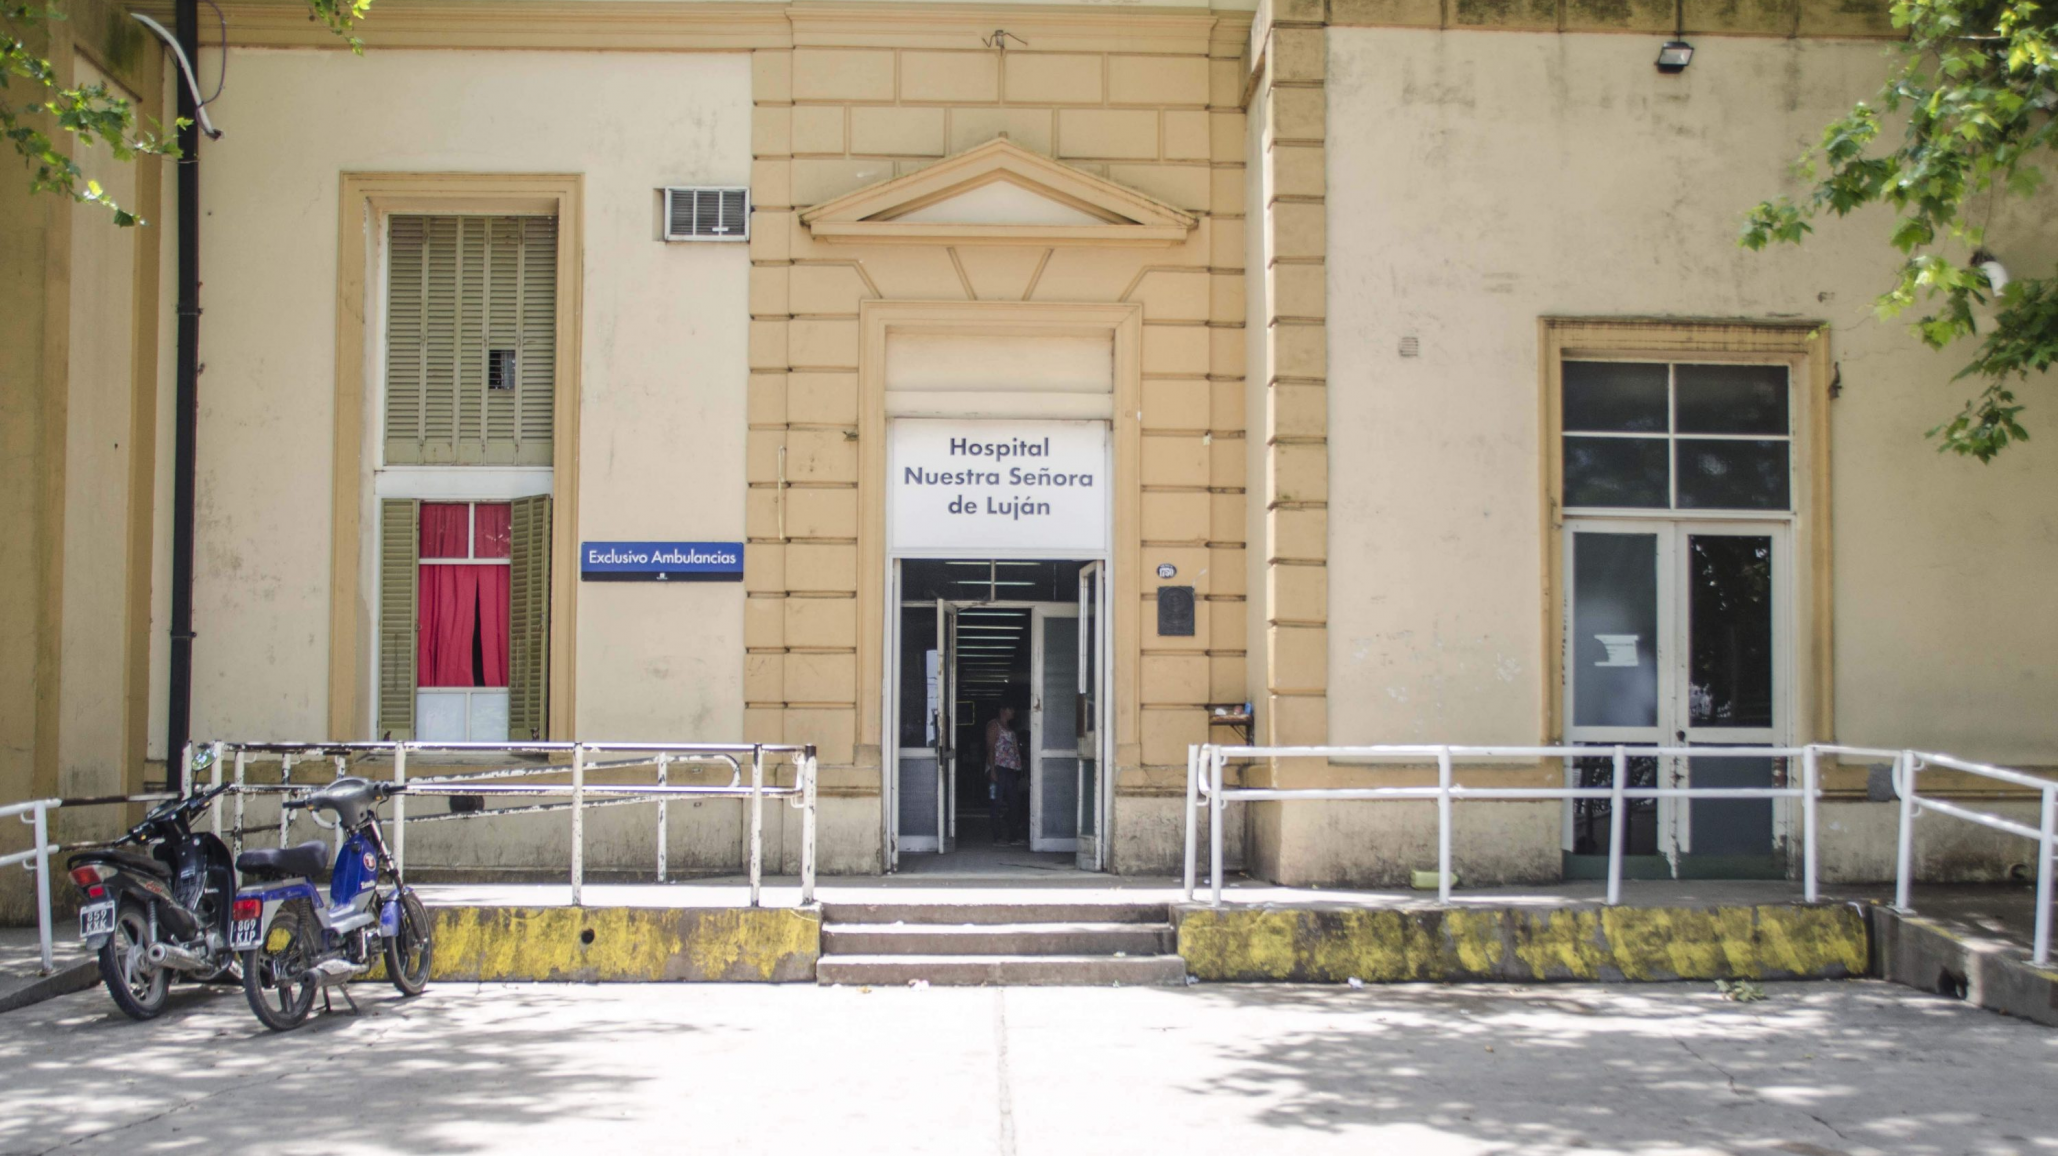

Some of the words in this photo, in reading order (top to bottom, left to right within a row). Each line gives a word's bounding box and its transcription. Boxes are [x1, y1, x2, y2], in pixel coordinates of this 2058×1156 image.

[950, 437, 1049, 462] Hospital
[904, 467, 1000, 485] Nuestra
[1009, 467, 1093, 487] Señora
[948, 495, 977, 515] de
[987, 496, 1050, 521] Luján
[589, 548, 648, 564] Exclusivo
[651, 548, 736, 564] Ambulancias
[87, 910, 107, 922] 859
[86, 919, 107, 932] KXK
[237, 919, 256, 931] 809
[236, 930, 256, 943] KIP
